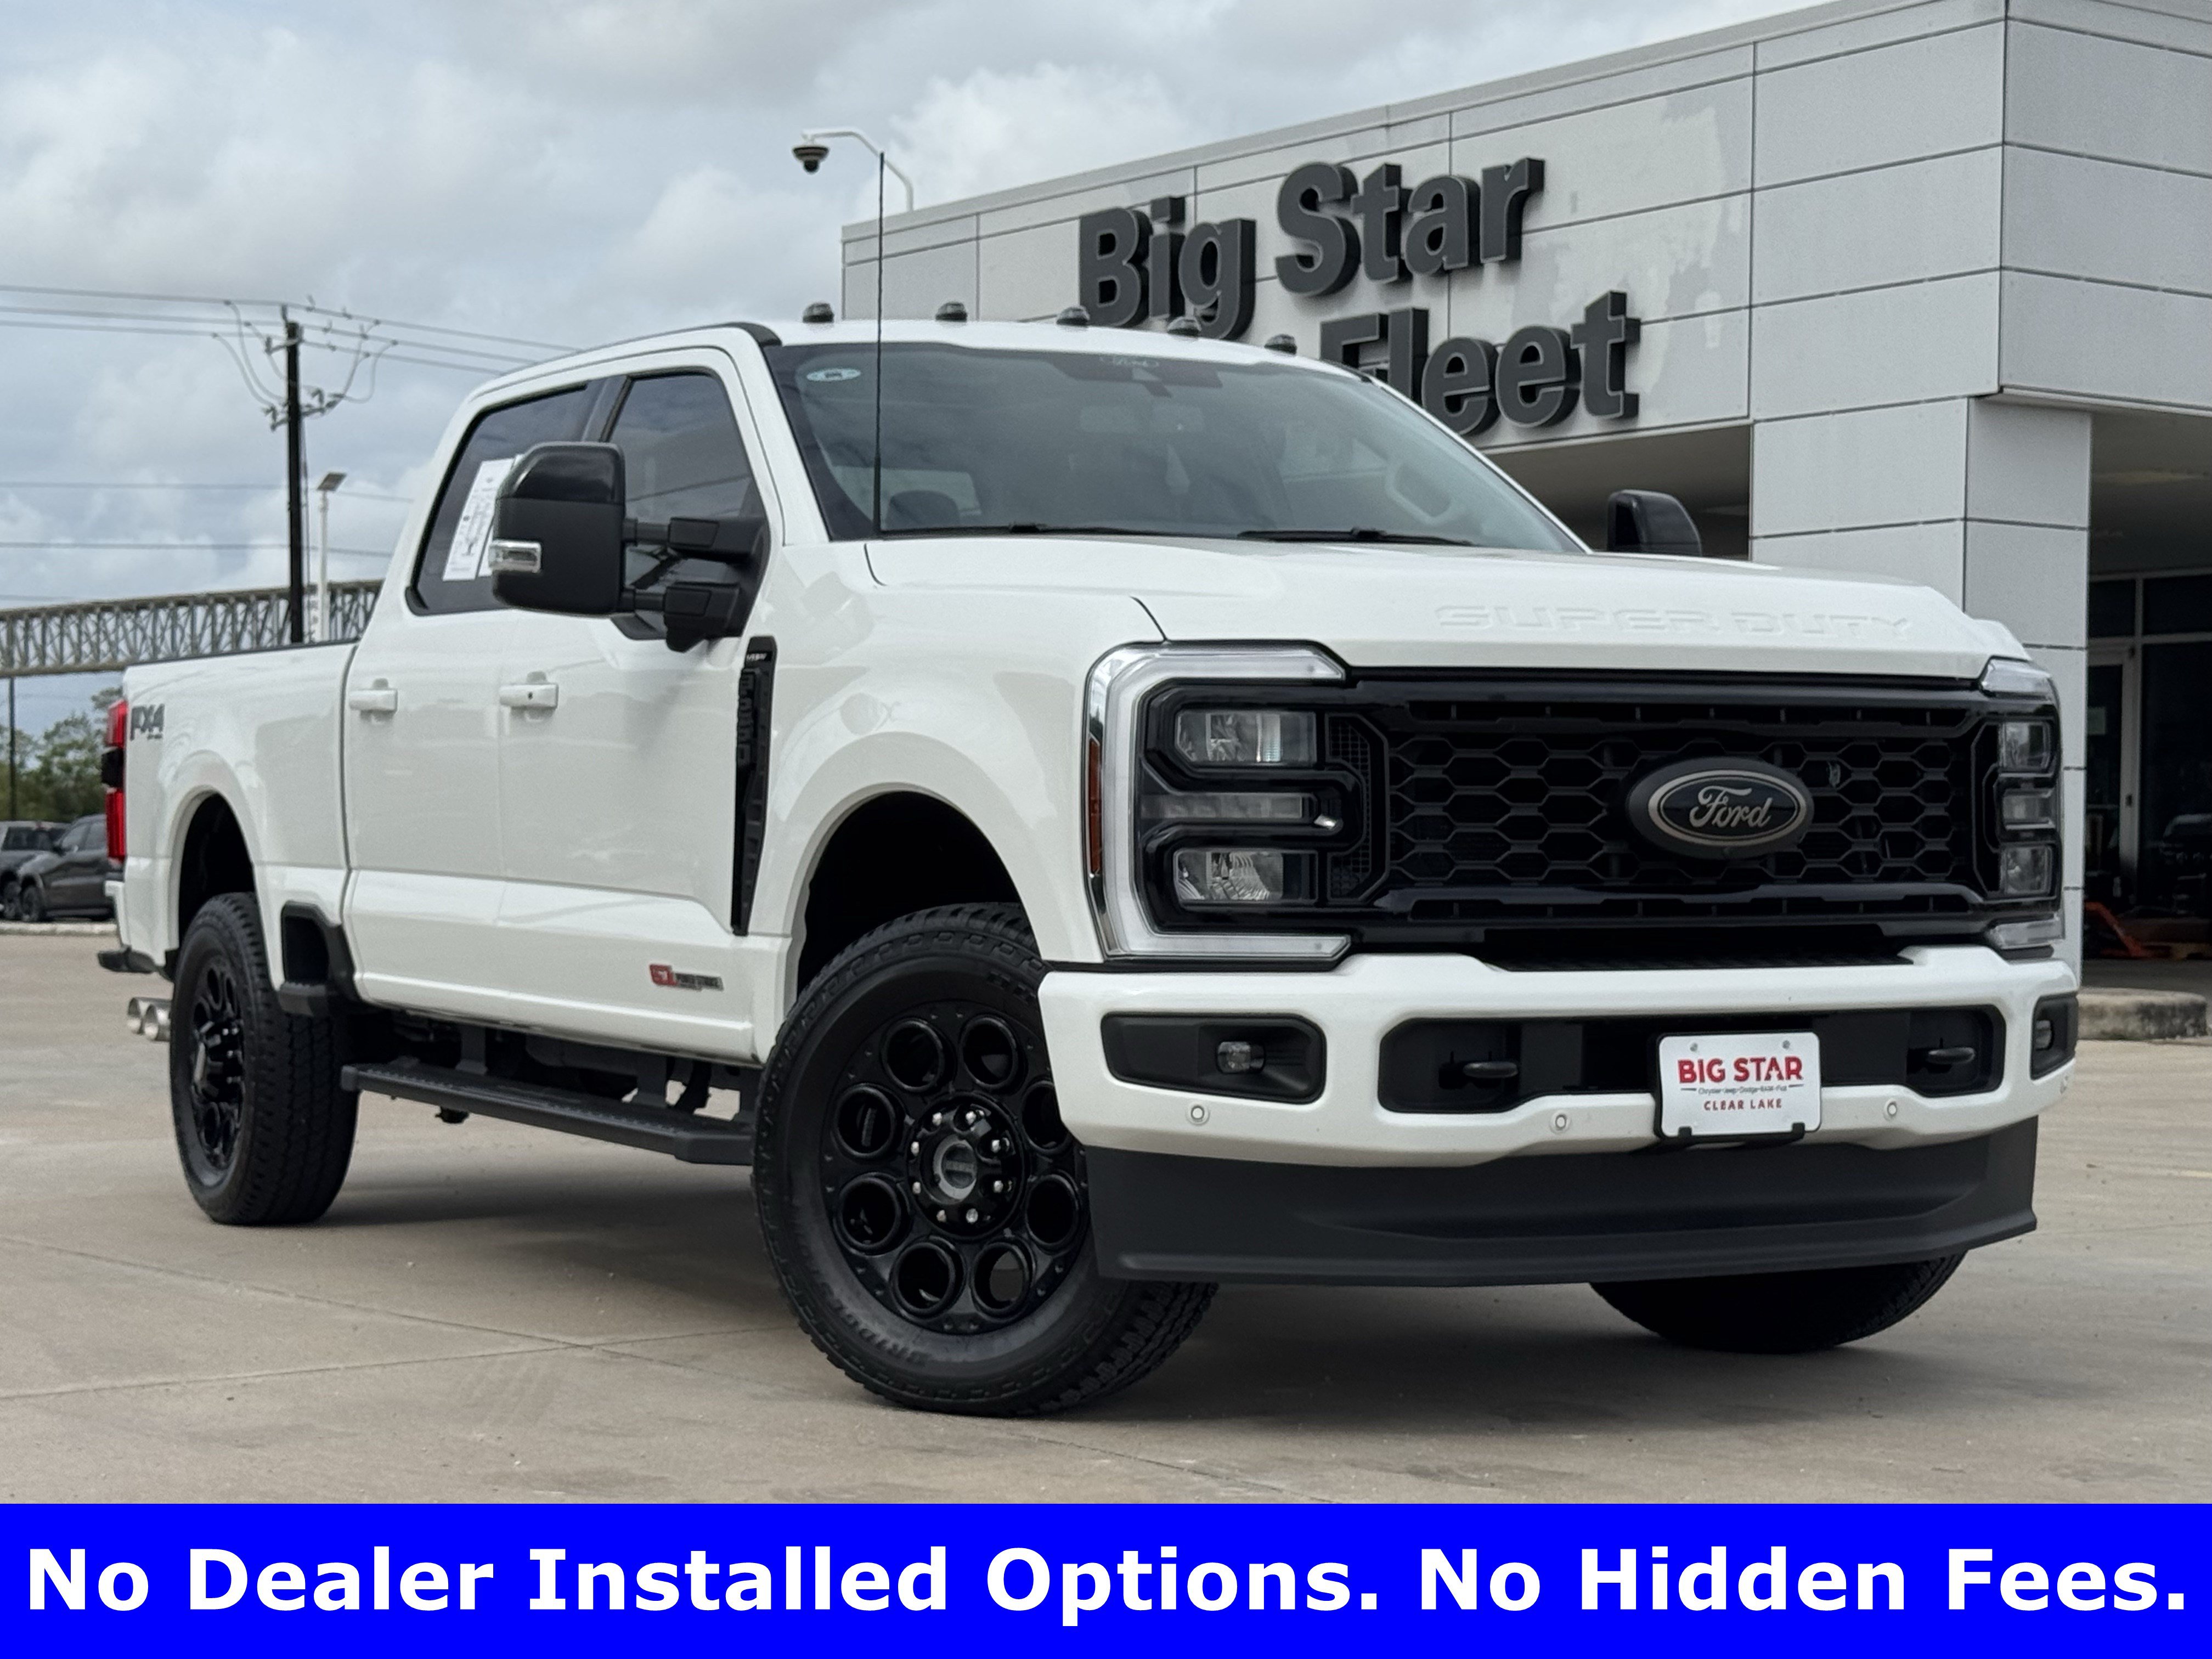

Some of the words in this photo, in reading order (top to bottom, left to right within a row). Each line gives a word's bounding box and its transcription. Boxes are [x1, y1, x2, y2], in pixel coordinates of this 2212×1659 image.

[1079, 196, 1257, 341] Big
[1274, 158, 1545, 297] Star
[1434, 604, 1722, 634] SUPER
[1730, 611, 1912, 641] DUTY
[1689, 785, 1773, 828] Ford
[1677, 1058, 1726, 1084] BIG
[1733, 1056, 1804, 1082] STAR
[1703, 1099, 1745, 1111] CLEAR
[1750, 1098, 1783, 1110] LAKE
